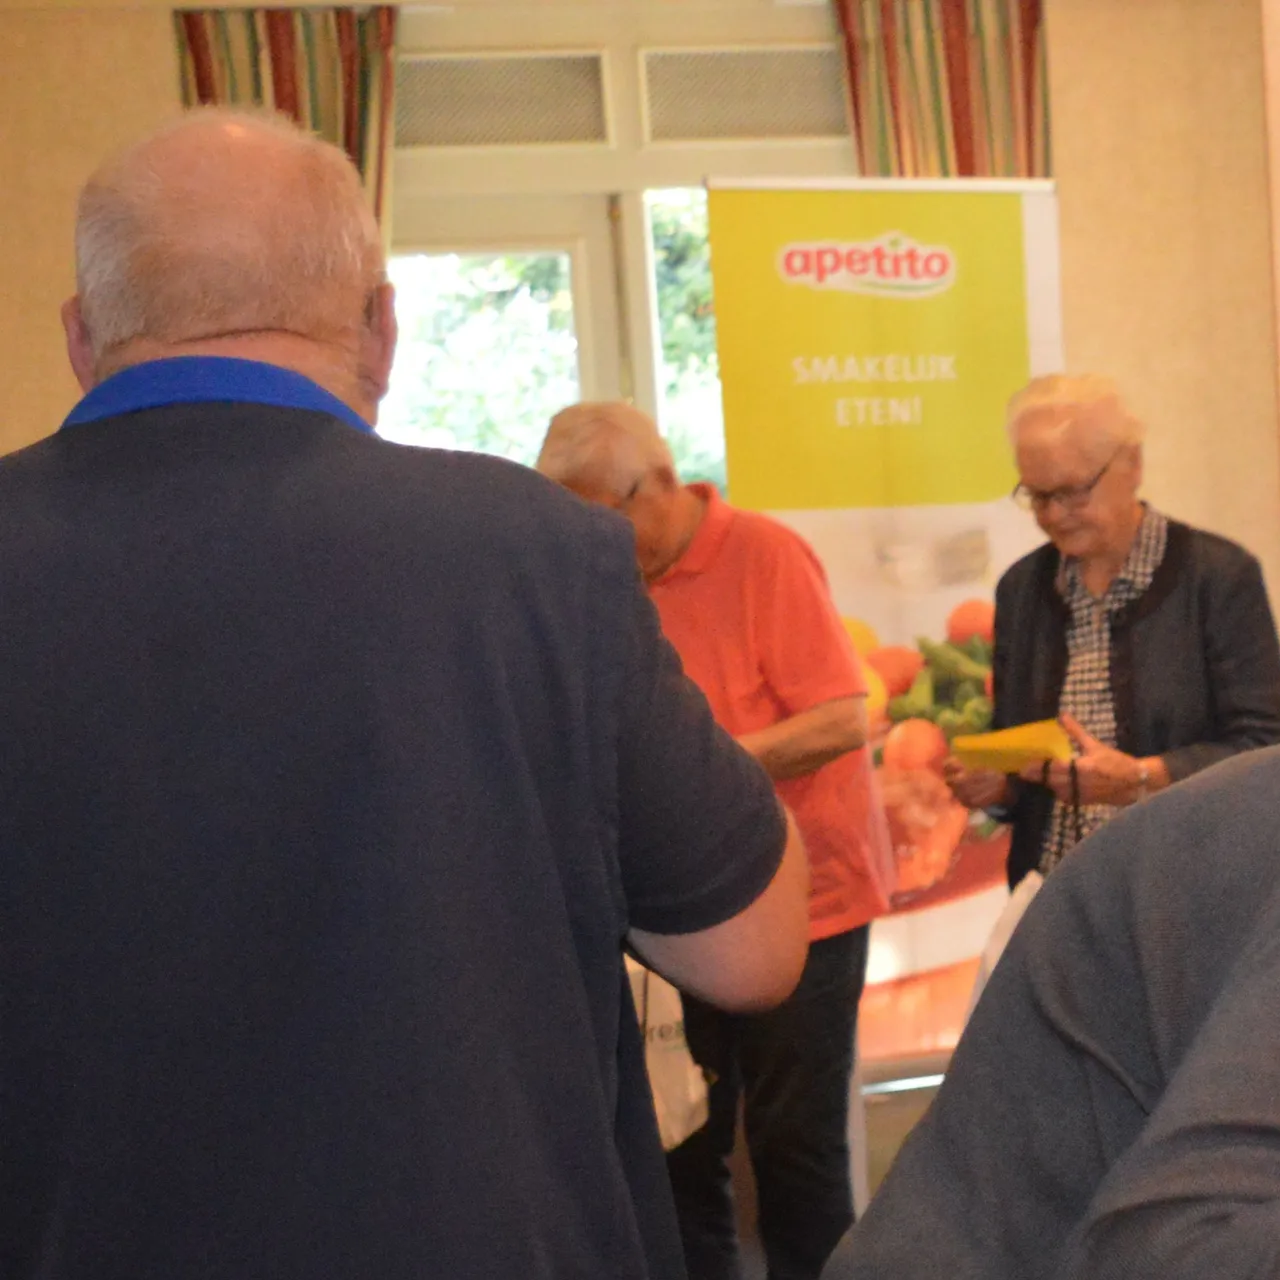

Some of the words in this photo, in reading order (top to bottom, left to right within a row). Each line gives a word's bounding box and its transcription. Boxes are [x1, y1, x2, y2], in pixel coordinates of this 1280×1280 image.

[784, 241, 950, 283] apetito
[792, 353, 957, 385] SMAKELIJK
[834, 395, 922, 427] ETEN!
